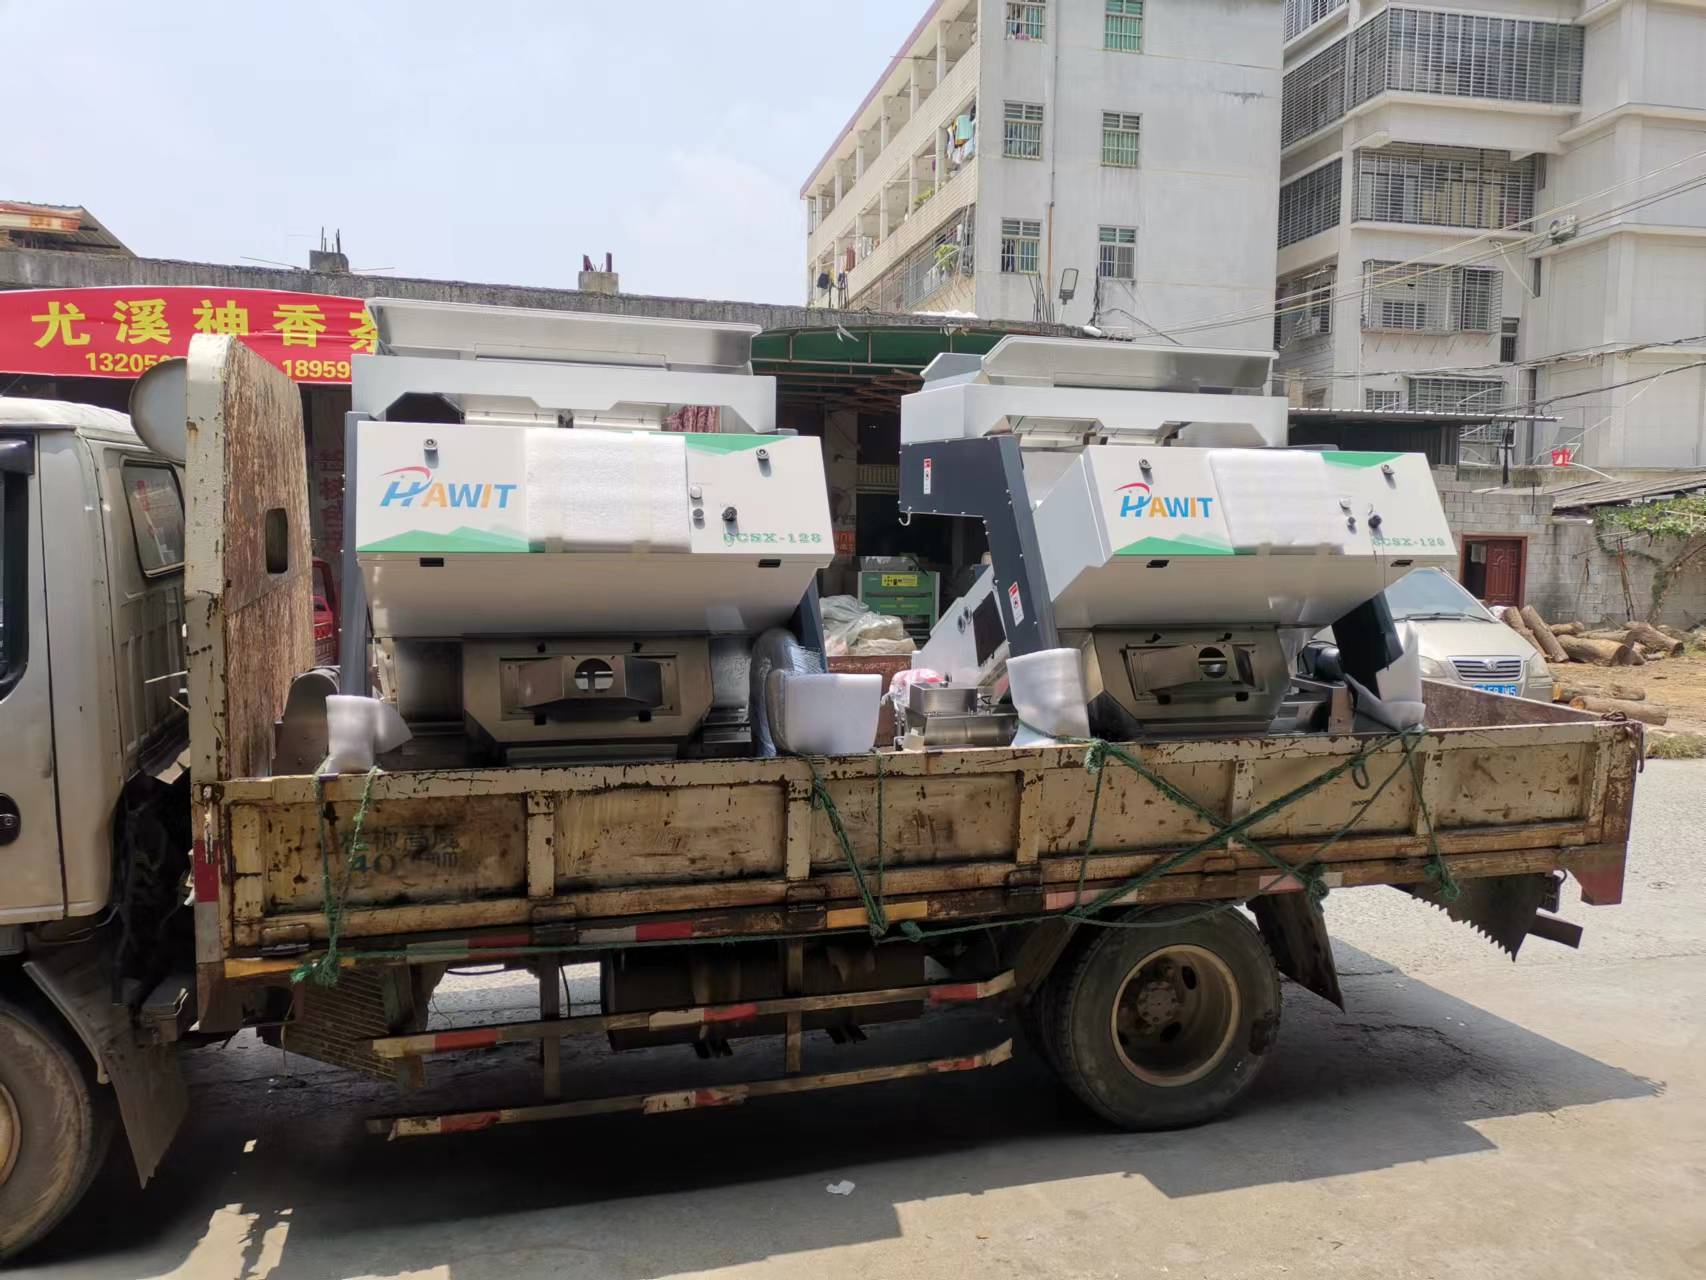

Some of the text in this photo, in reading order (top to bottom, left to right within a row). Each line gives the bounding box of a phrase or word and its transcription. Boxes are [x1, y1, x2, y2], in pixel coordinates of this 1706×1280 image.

[85, 352, 352, 379] 13205 18959
[380, 478, 517, 508] HAWIT
[1120, 492, 1213, 518] HAWIT
